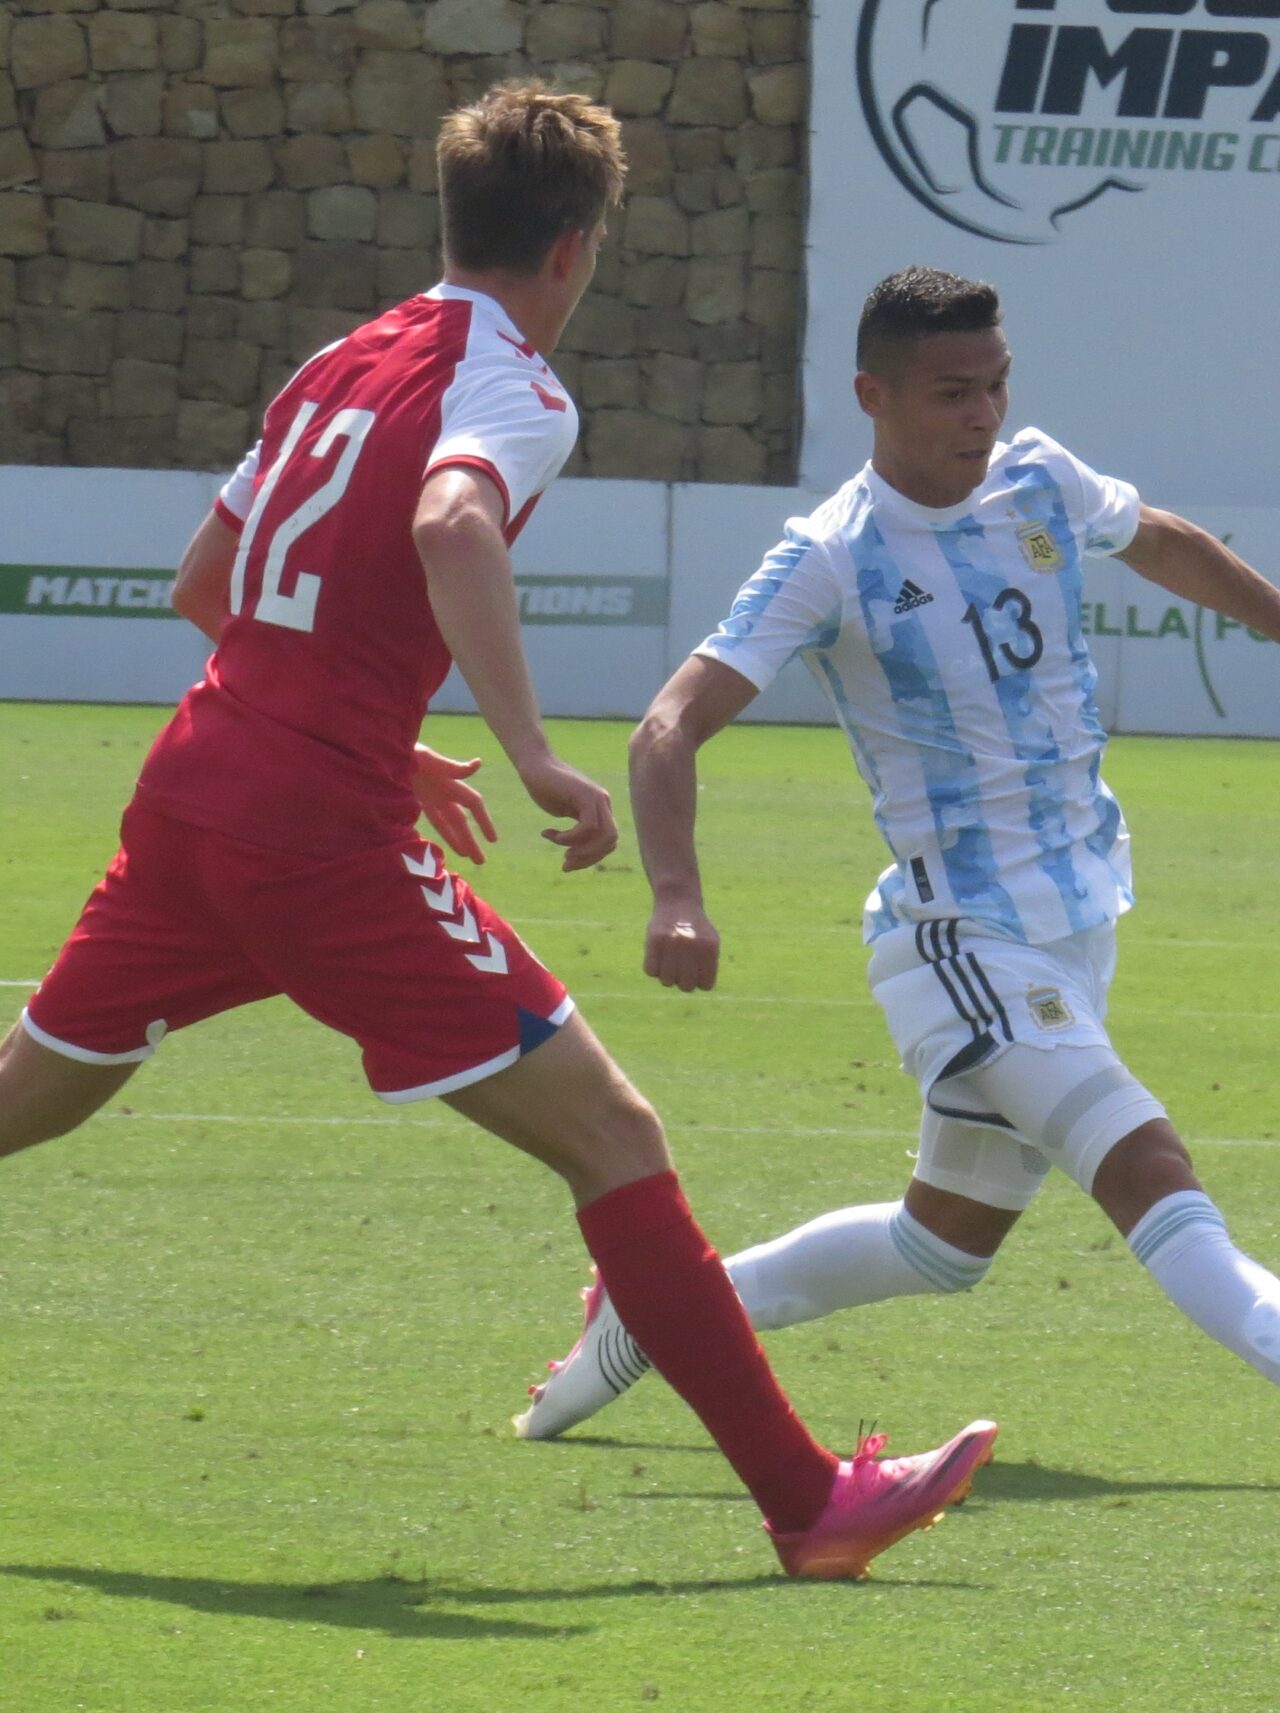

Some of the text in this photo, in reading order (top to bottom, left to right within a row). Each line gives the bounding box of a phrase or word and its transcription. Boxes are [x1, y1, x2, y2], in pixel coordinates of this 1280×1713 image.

[993, 124, 1239, 172] TRAINING
[230, 400, 376, 632] 12
[893, 592, 934, 615] adidas
[962, 588, 1043, 682] 13
